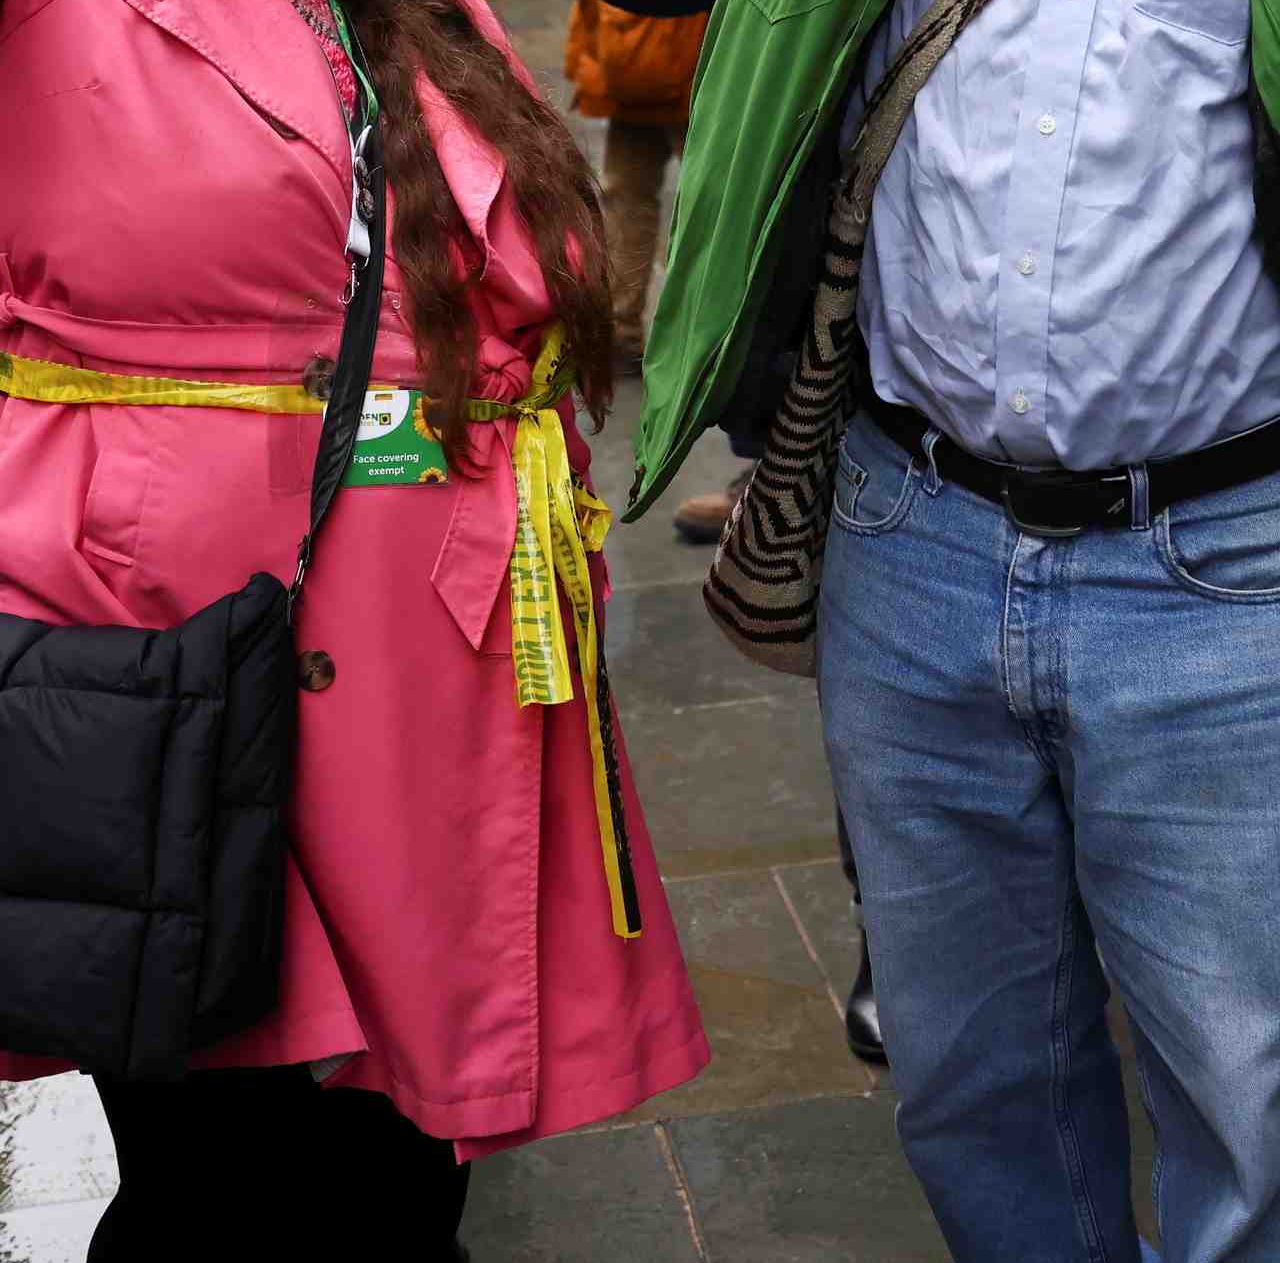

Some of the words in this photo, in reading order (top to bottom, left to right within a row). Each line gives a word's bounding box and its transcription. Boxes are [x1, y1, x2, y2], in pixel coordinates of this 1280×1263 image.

[353, 454, 376, 464] Face
[377, 452, 419, 464] covering
[368, 466, 405, 477] exempt
